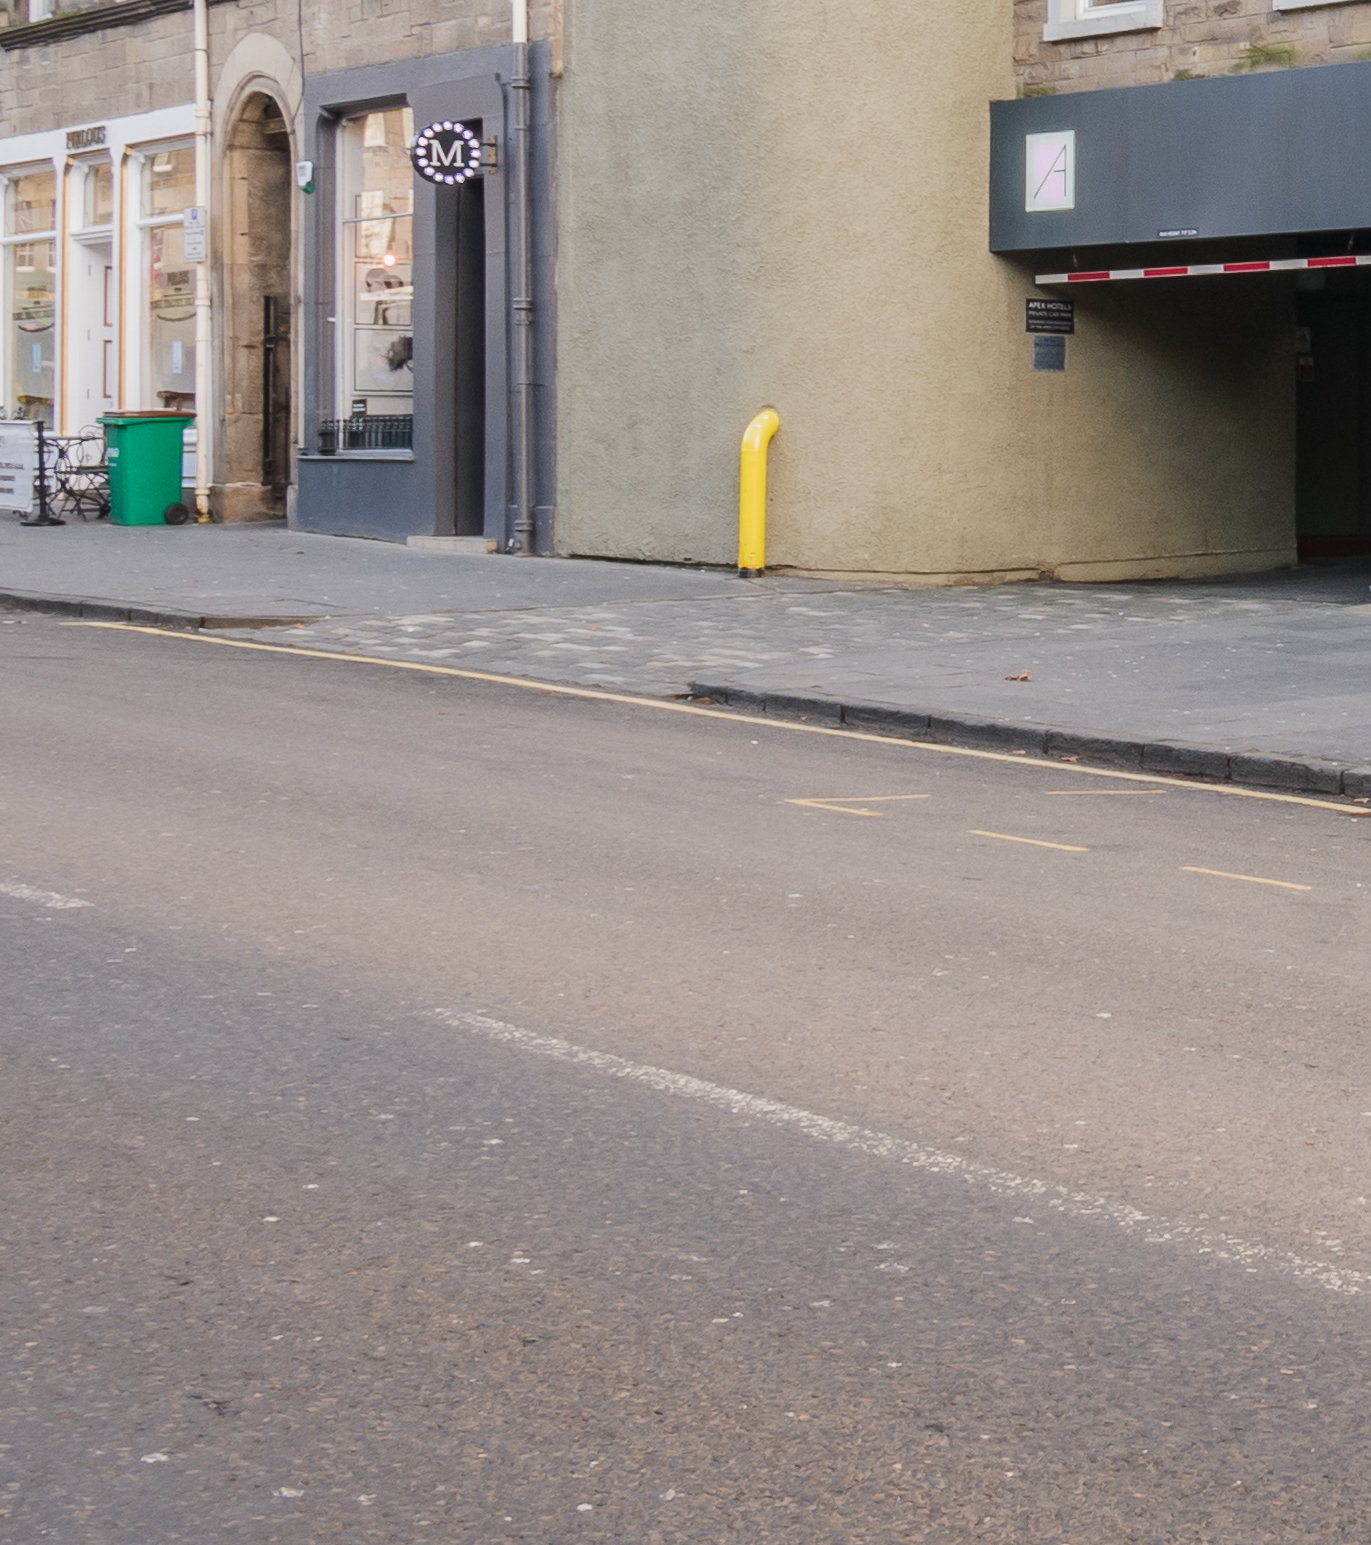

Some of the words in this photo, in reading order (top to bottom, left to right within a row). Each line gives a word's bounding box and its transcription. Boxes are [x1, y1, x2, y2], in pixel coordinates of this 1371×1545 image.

[428, 139, 466, 168] M
[1028, 301, 1046, 310] APEX
[1046, 302, 1072, 311] HOTELS
